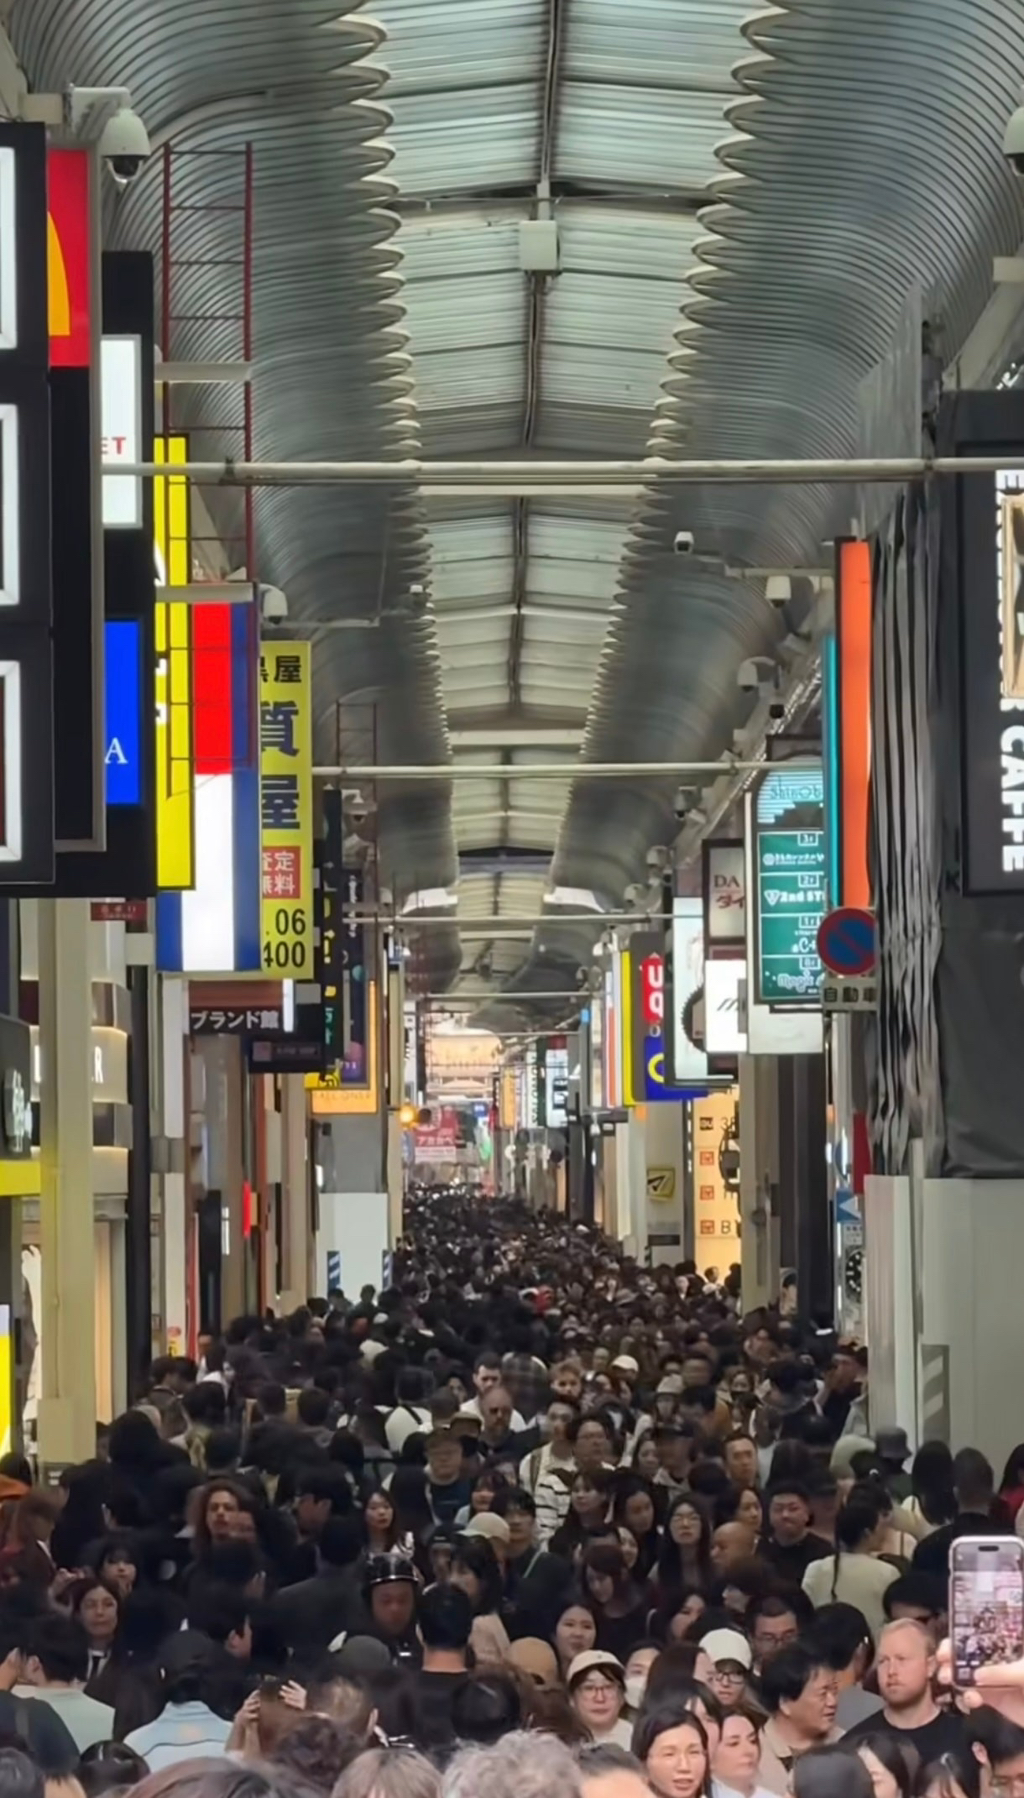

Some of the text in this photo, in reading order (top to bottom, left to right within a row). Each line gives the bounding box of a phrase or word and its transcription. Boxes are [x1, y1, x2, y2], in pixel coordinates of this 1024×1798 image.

[191, 1010, 279, 1030] ブランド館
